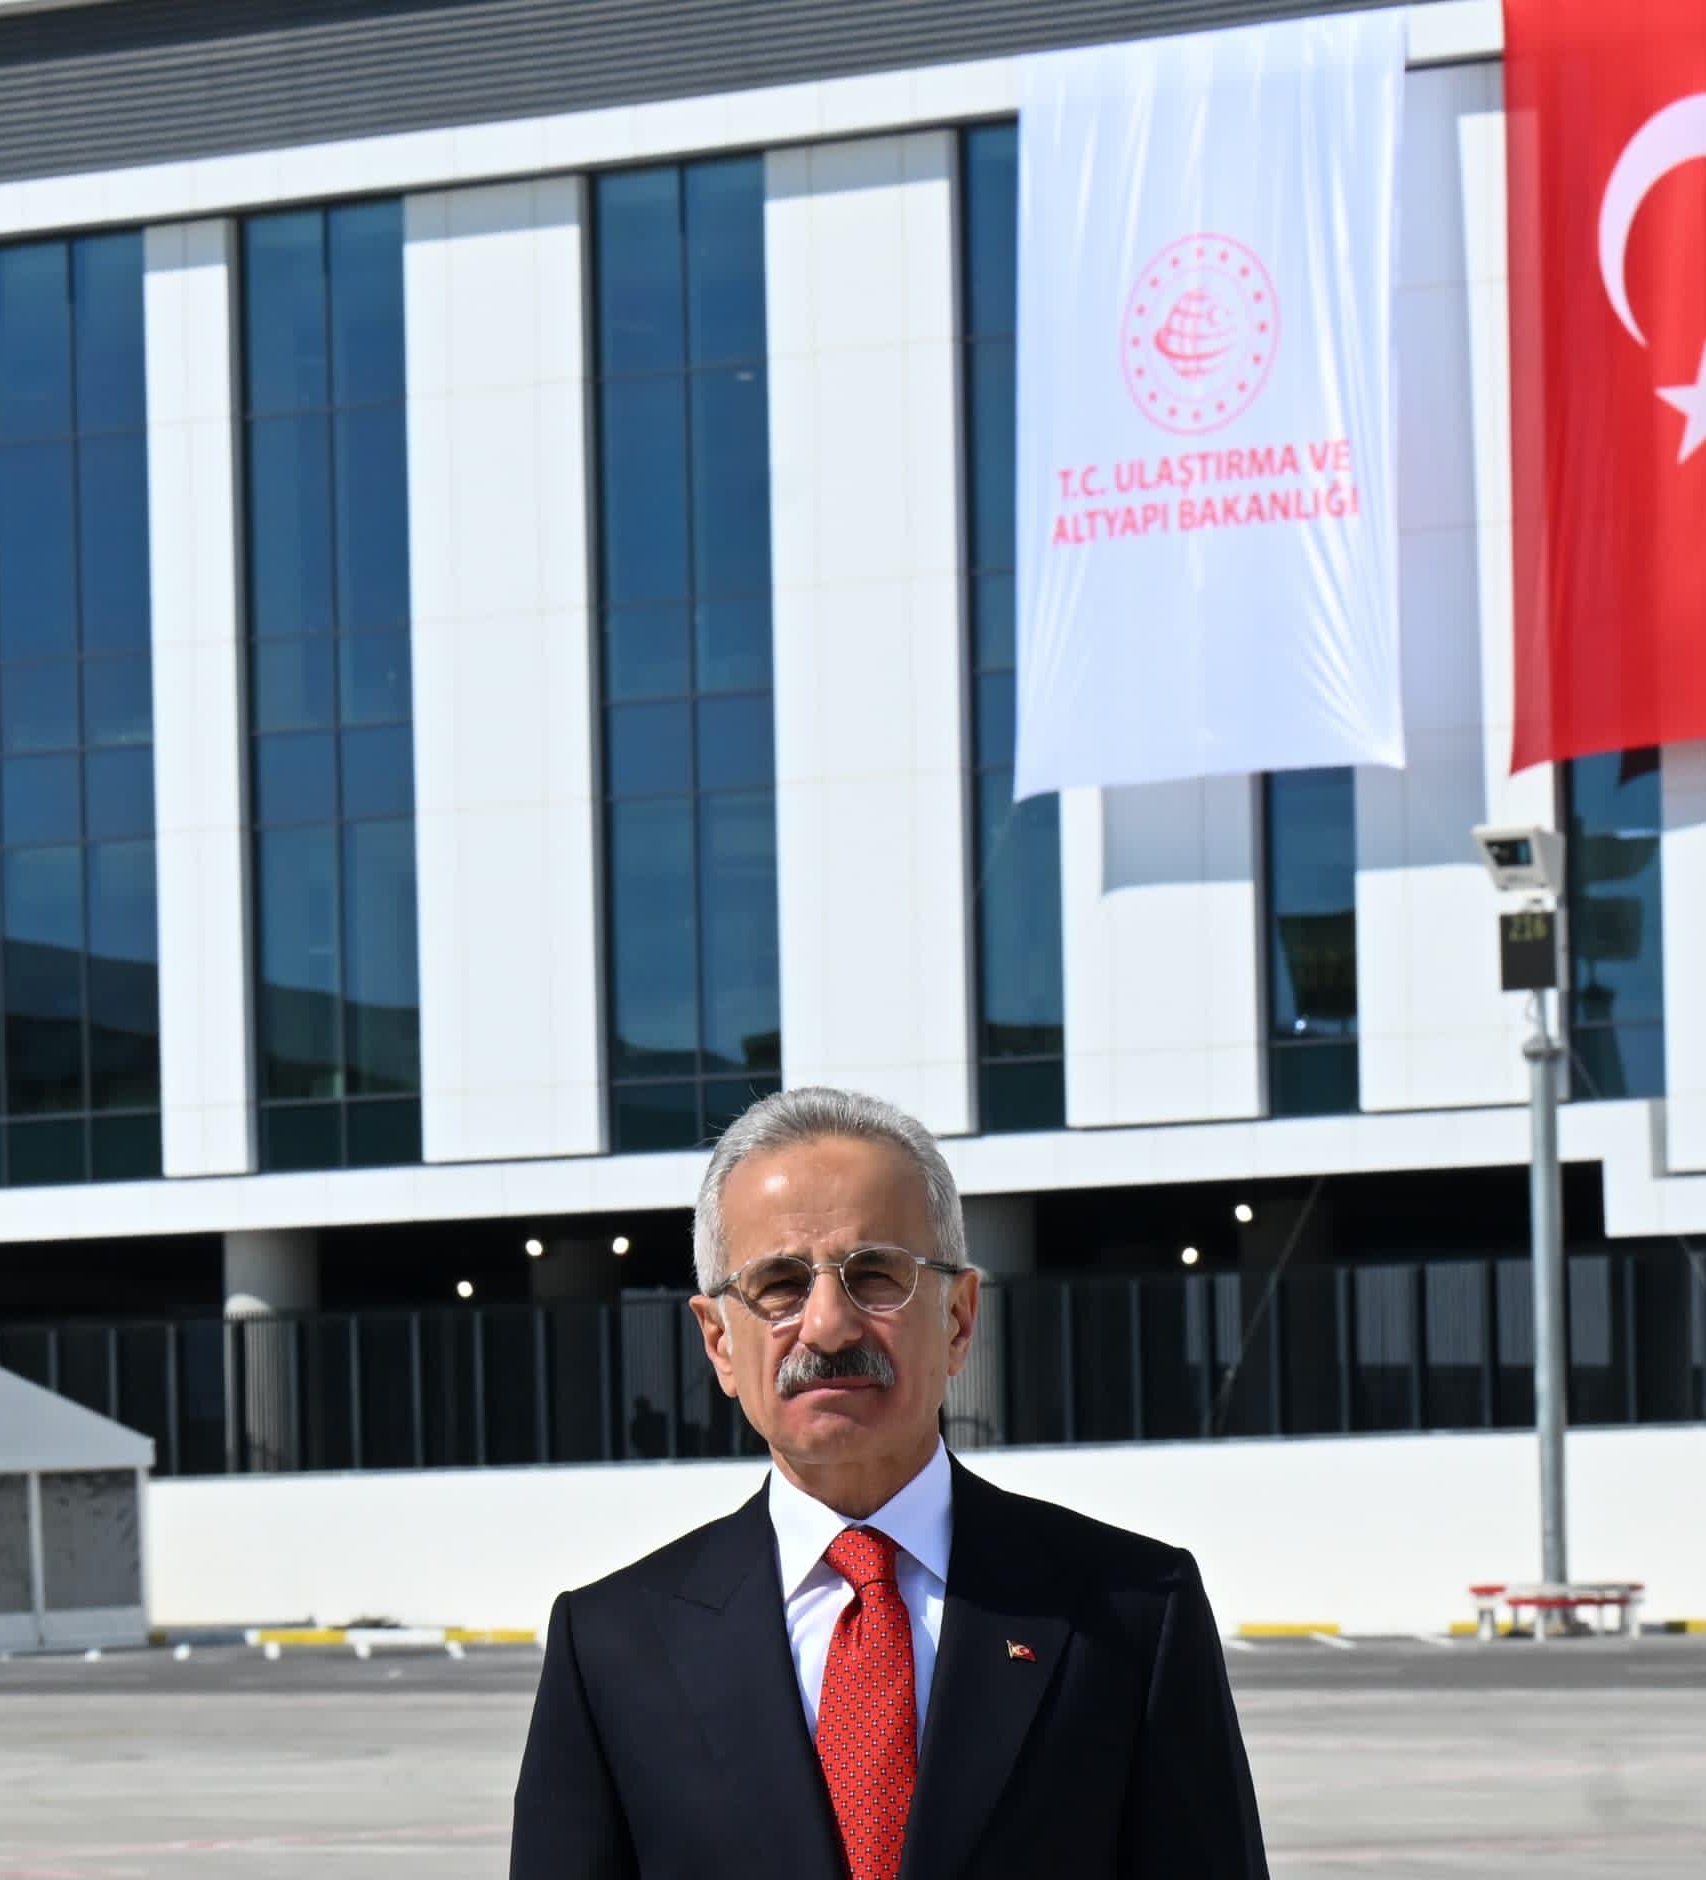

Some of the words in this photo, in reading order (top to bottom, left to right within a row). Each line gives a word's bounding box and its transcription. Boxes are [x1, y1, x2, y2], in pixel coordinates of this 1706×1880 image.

[1057, 465, 1108, 498] T.C.
[1114, 443, 1300, 495] ULAŞTIRMA
[1309, 438, 1351, 474] VE
[1052, 502, 1170, 545] ALTYAPI
[1177, 479, 1360, 532] BAKANLIĞI
